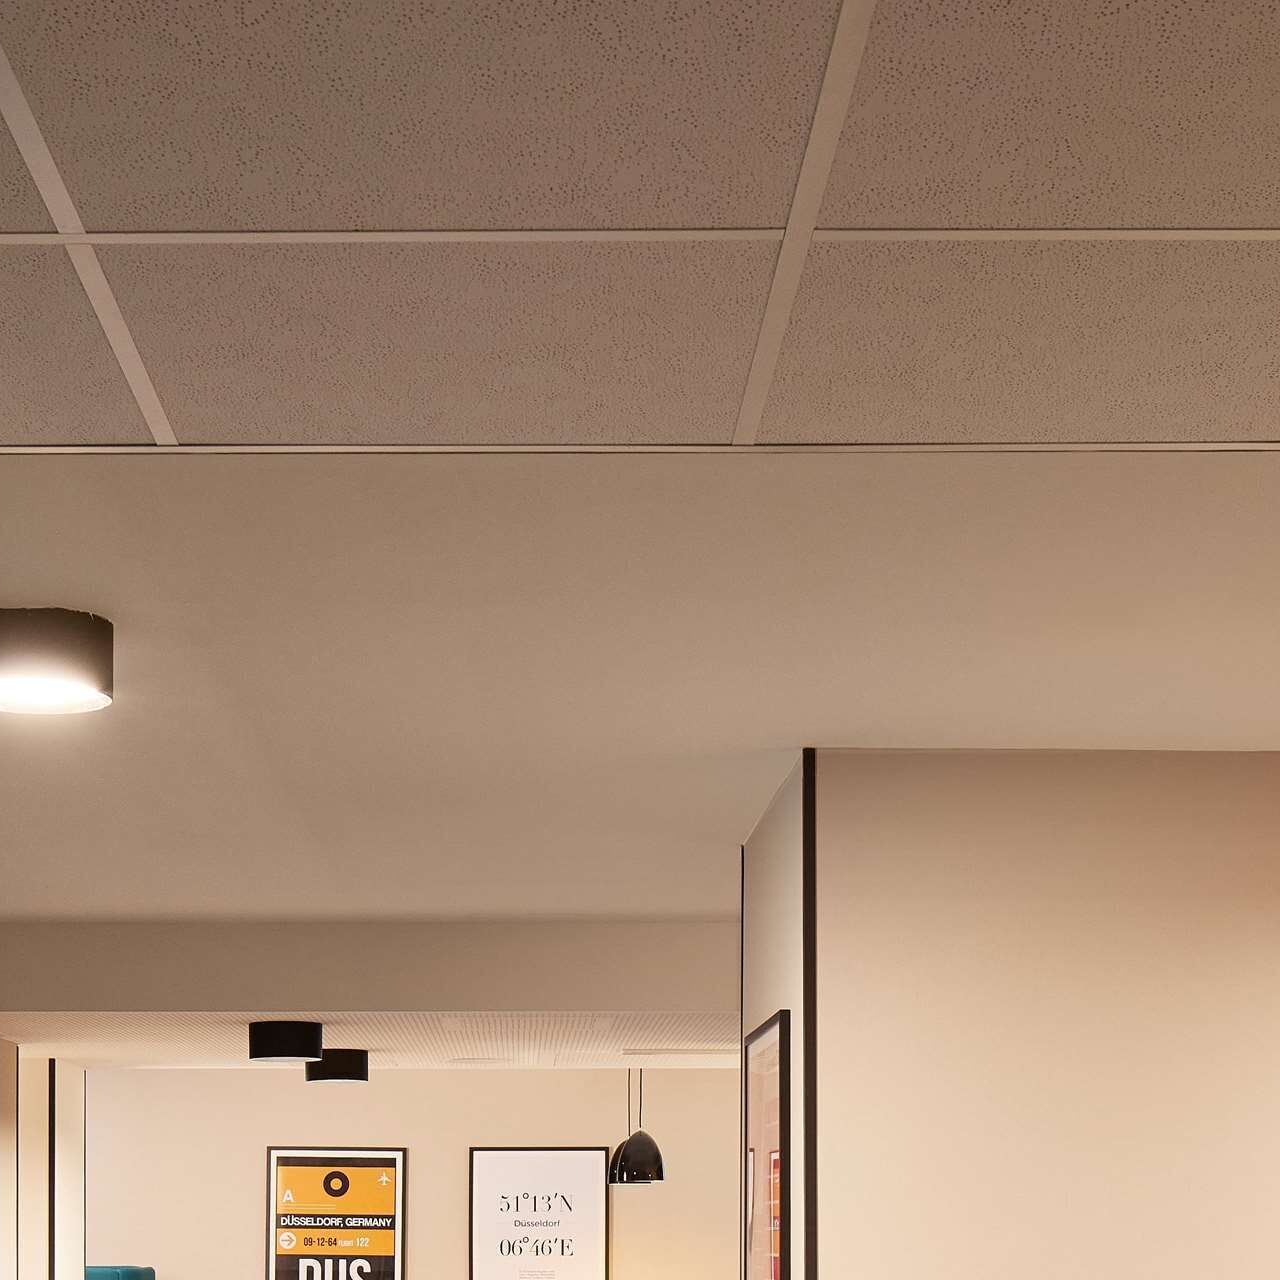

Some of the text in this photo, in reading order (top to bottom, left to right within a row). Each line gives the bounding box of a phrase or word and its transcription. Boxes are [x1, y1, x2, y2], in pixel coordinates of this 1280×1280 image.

[282, 1189, 294, 1203] A
[280, 1214, 393, 1228] DÜSSELDORF, GERMANY
[513, 1219, 561, 1228] Düsseldorf
[303, 1237, 337, 1247] 09-12-64
[356, 1237, 370, 1247] 122
